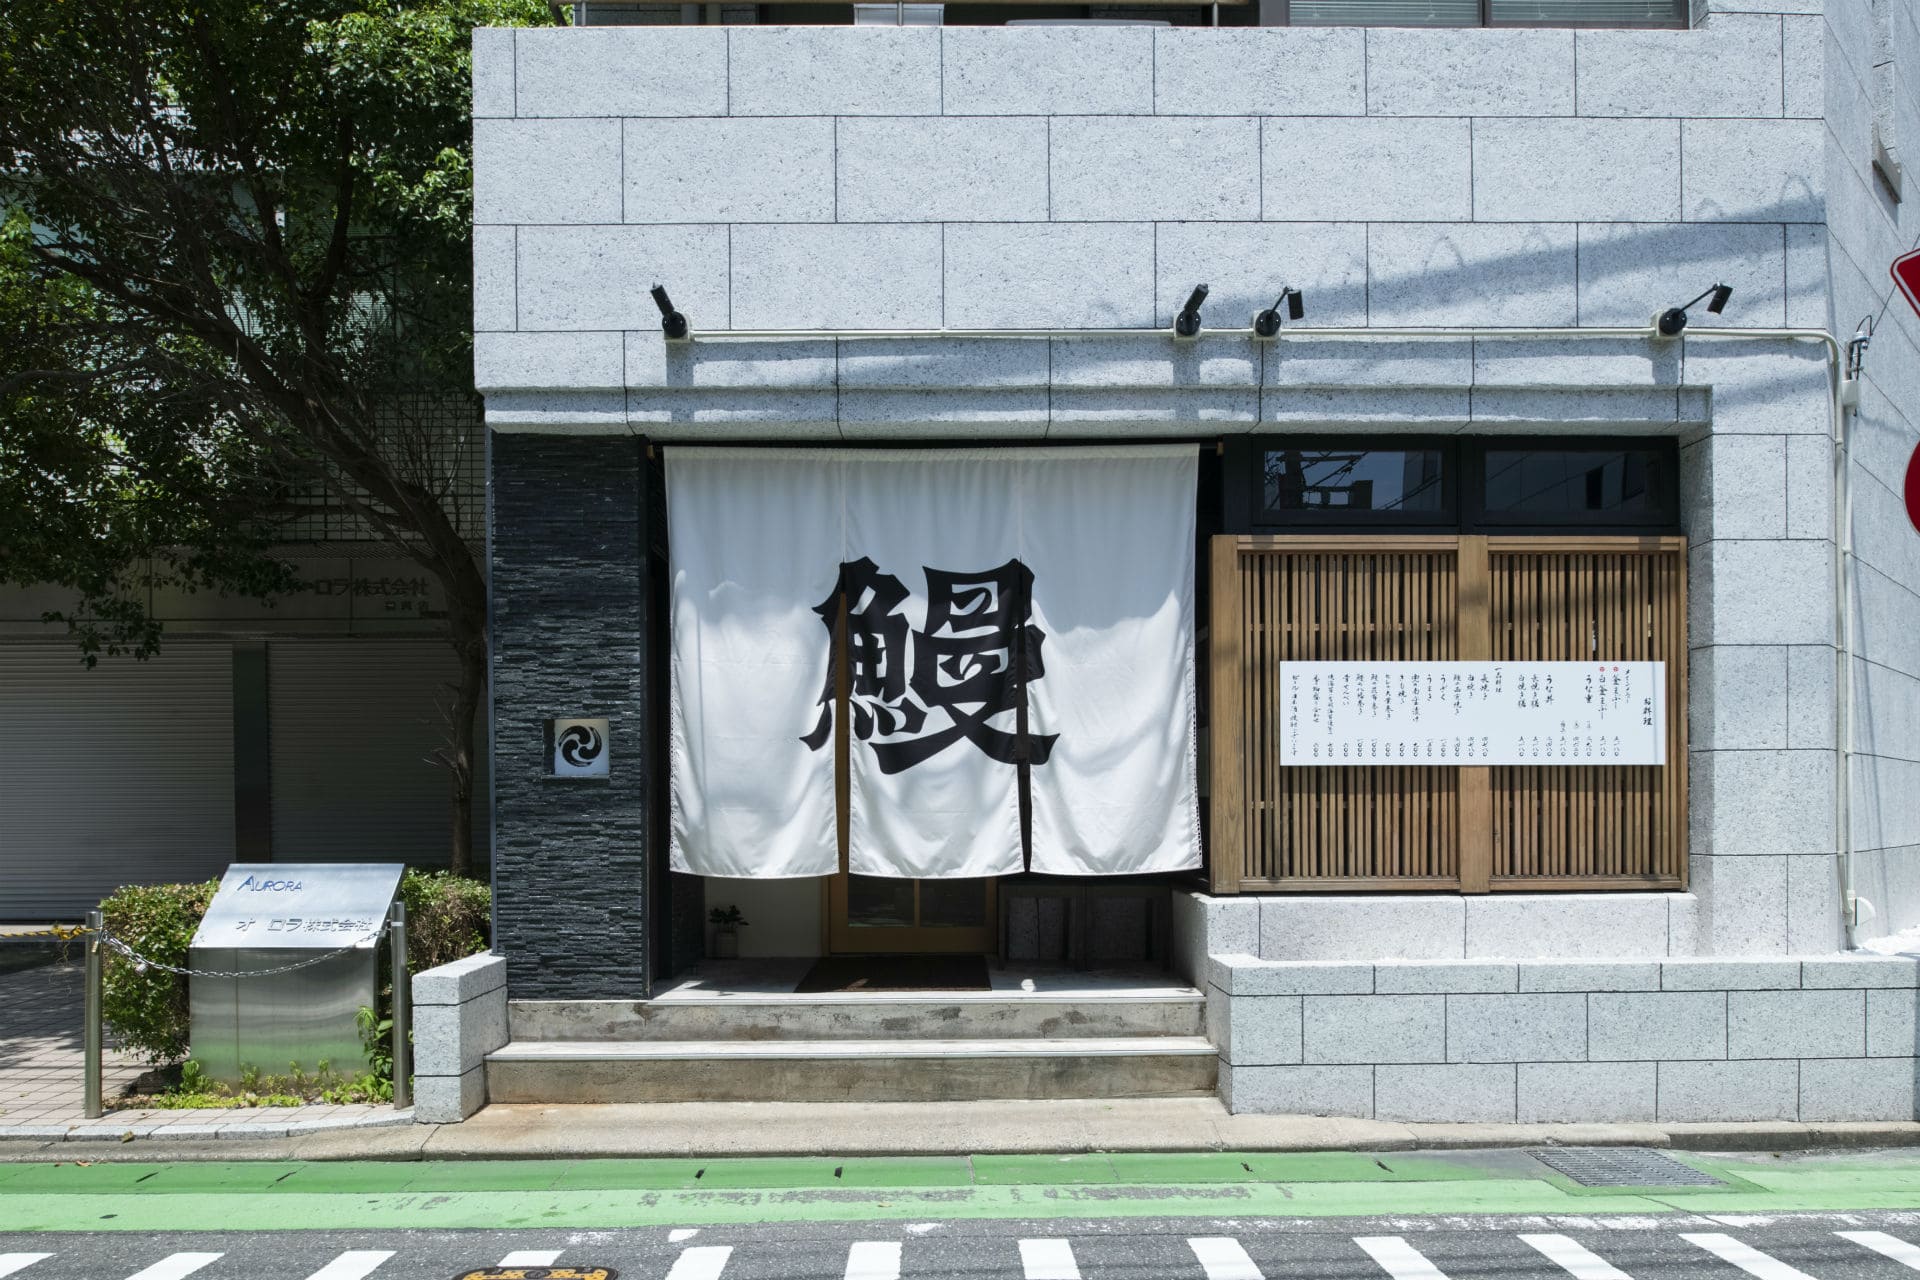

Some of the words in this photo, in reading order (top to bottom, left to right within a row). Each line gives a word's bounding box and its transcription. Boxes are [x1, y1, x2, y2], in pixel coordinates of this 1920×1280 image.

[799, 555, 1061, 775] 鰻
[1584, 674, 1593, 704] うな重
